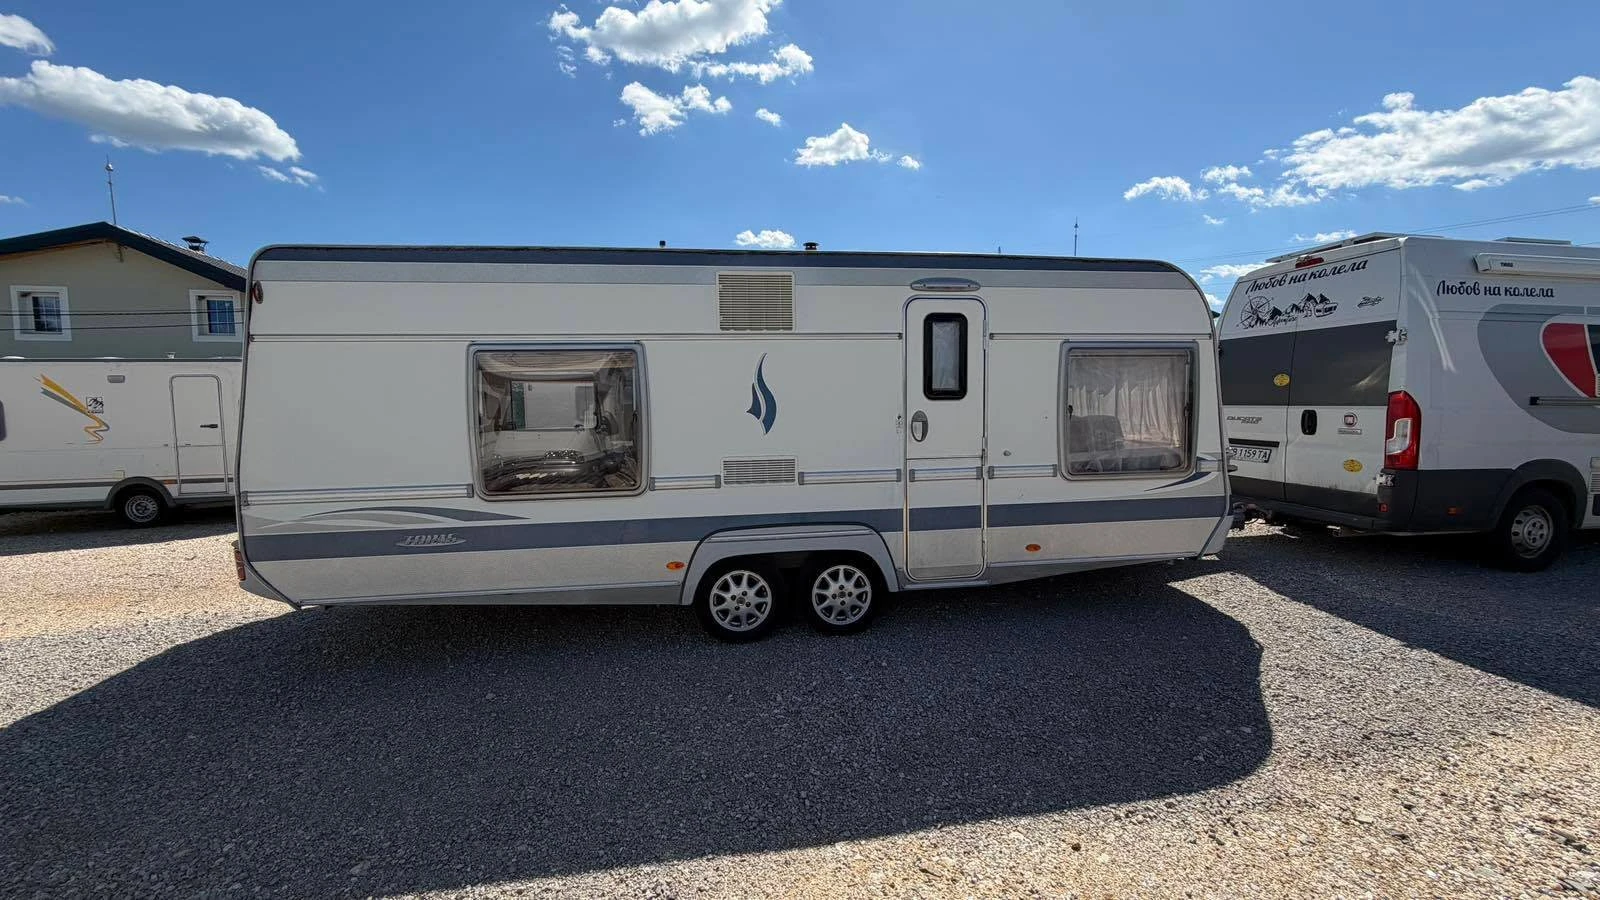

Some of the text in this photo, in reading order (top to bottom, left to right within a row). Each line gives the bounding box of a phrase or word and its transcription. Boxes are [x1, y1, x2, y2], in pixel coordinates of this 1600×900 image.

[1245, 259, 1369, 295] Любов на колела
[1436, 280, 1555, 298] Любов на колела
